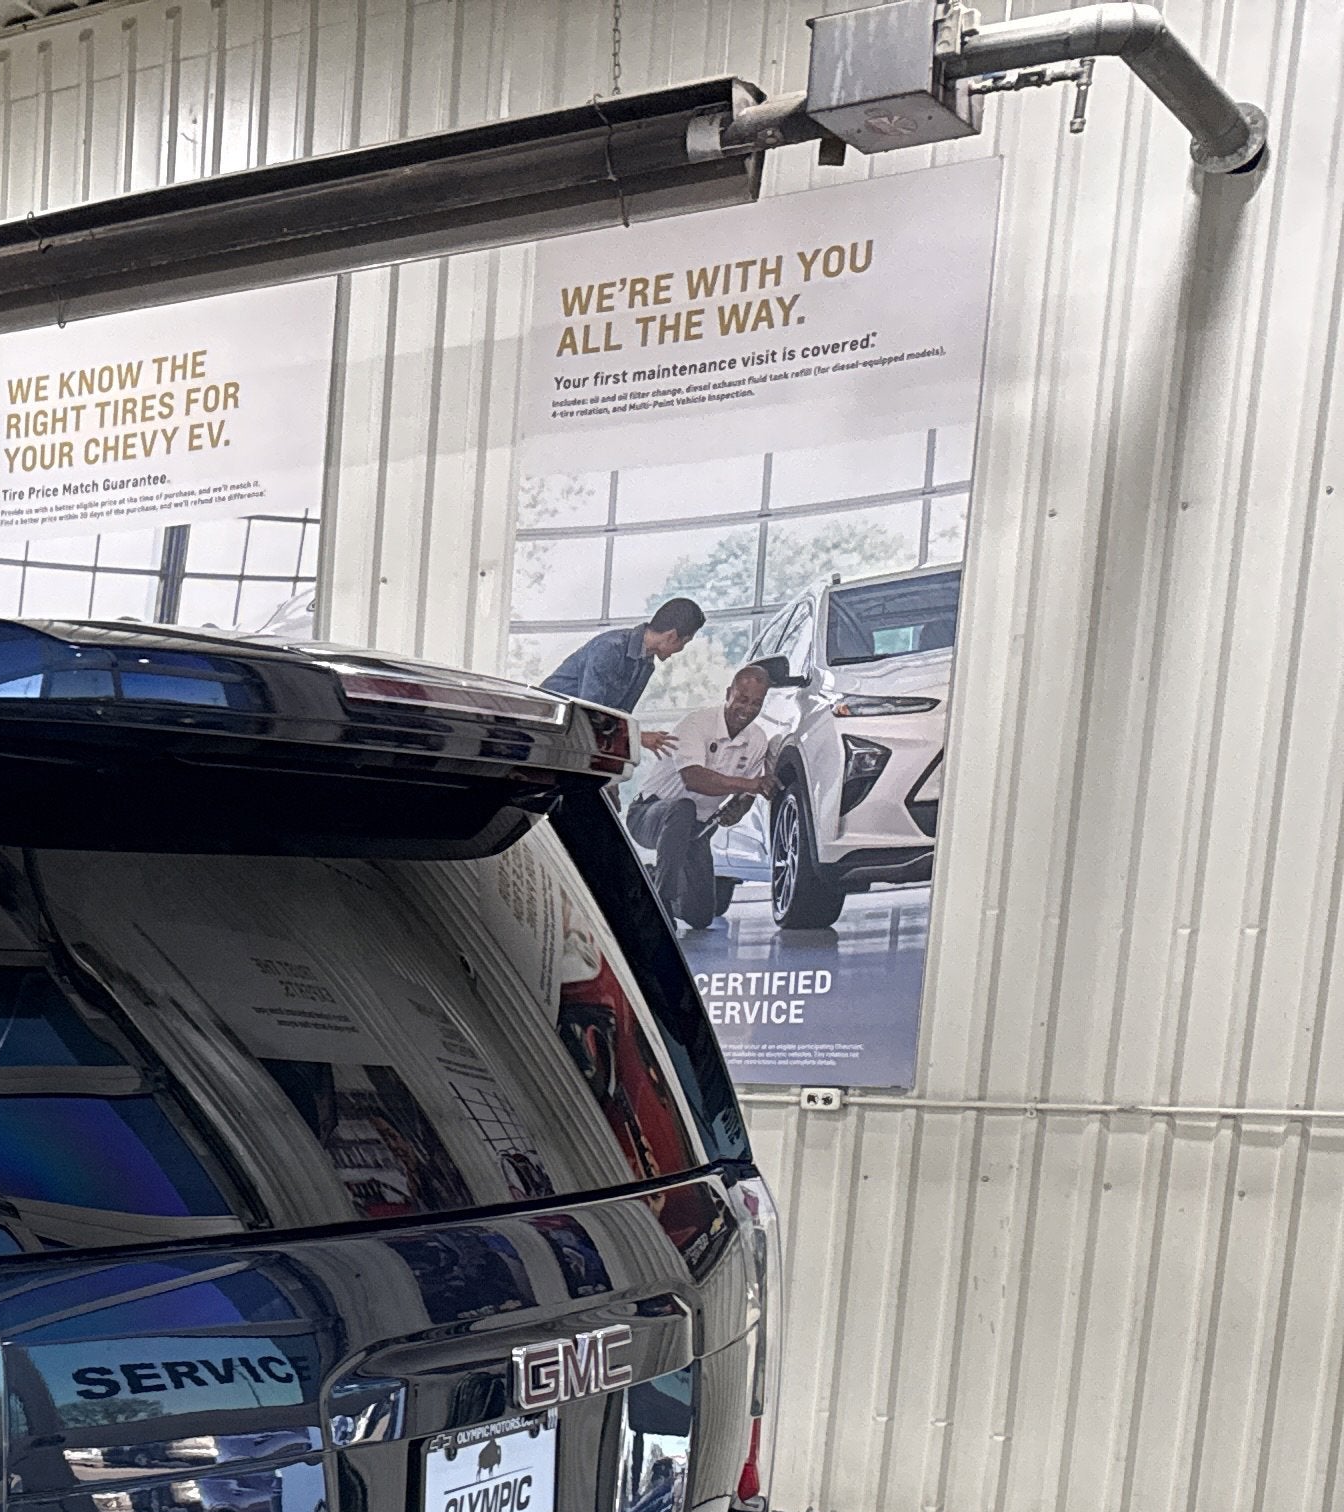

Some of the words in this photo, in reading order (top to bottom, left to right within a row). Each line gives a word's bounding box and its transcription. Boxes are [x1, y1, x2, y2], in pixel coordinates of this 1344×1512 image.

[561, 272, 674, 317] WE'RE
[685, 255, 784, 301] WITH
[796, 239, 874, 281] YOU
[555, 318, 623, 357] ALL
[635, 307, 706, 348] THE
[717, 294, 806, 337] WAY.
[7, 375, 49, 405] WE
[59, 361, 143, 398] KNOW
[152, 350, 207, 385] THE
[554, 376, 590, 391] Your
[593, 370, 628, 387] first
[632, 359, 737, 382] maintenance
[741, 350, 777, 368] visit
[782, 347, 796, 361] is
[6, 405, 87, 439] RIGHT
[95, 392, 174, 428] TIRES
[184, 381, 240, 416] FOR
[618, 392, 628, 401] oil
[4, 442, 74, 473] YOUR
[83, 427, 179, 465] CHEVY
[188, 420, 230, 451] EV.
[2, 488, 24, 500] Tire
[28, 485, 58, 499] Price
[62, 480, 99, 495] Match
[693, 970, 832, 996] CERTIFIED
[708, 1000, 805, 1024] ERVICE
[72, 1356, 310, 1399] SERVICE
[512, 1324, 632, 1409] GMC
